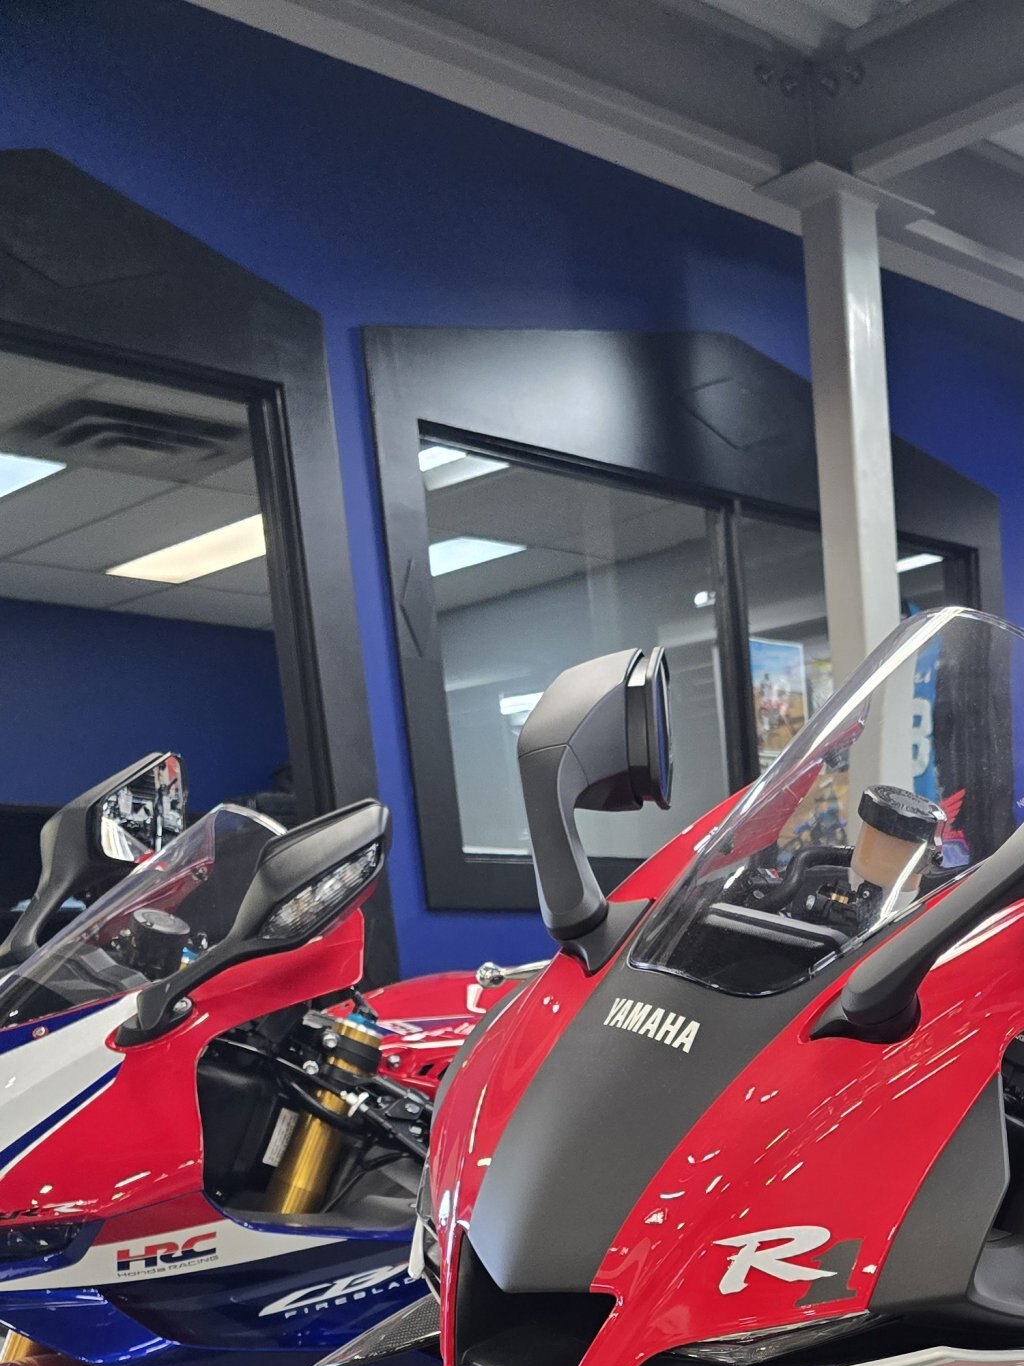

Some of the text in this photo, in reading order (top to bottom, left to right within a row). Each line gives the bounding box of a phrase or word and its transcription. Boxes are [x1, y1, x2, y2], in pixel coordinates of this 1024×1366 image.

[603, 997, 700, 1053] YAMAHA
[117, 1231, 217, 1271] HRC
[117, 1254, 219, 1278] Honda RACING
[711, 1225, 865, 1309] R1
